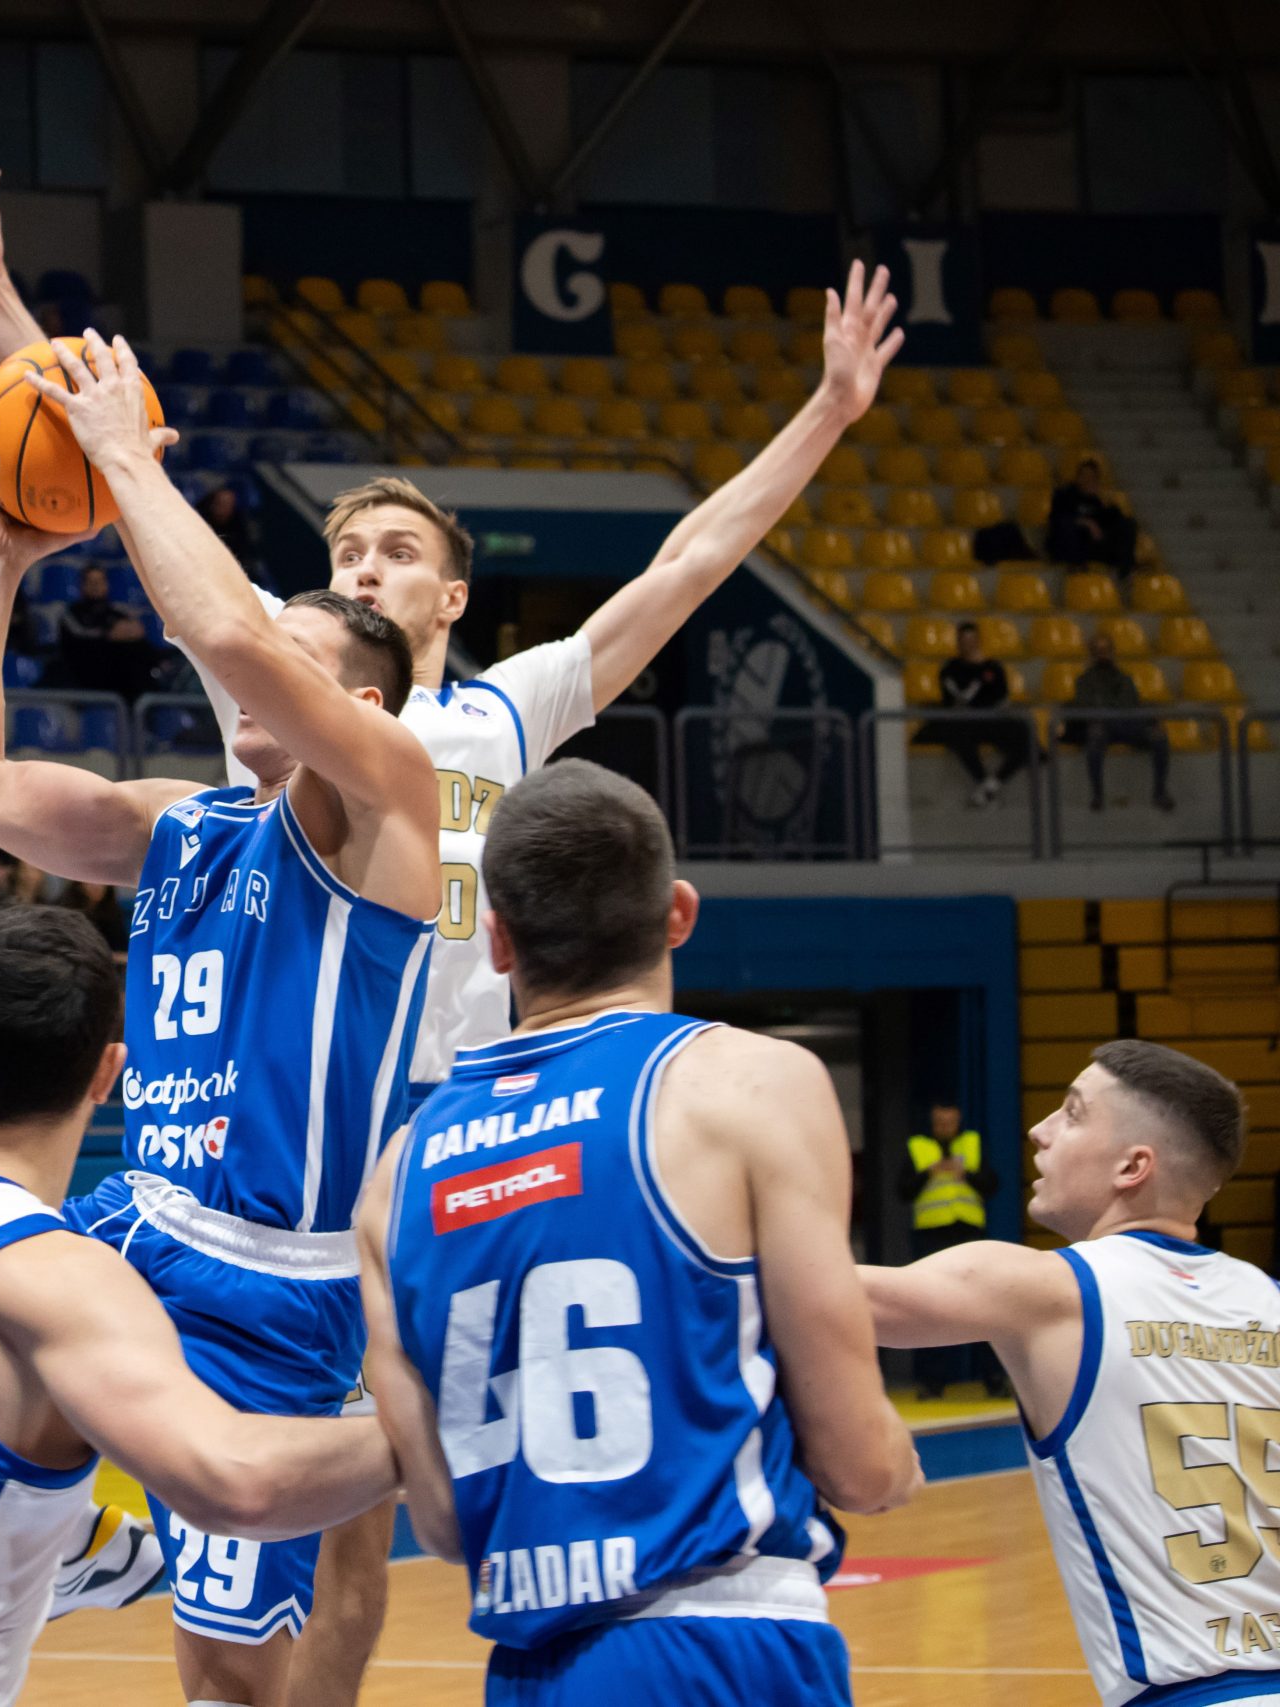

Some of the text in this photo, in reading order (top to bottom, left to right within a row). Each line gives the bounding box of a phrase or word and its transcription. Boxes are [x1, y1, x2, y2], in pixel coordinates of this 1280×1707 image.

[152, 949, 224, 1041] 29
[138, 1124, 207, 1170] PSK
[421, 1087, 605, 1170] RAMLJAK
[445, 1164, 566, 1214] PETROL
[438, 1257, 654, 1484] 46
[169, 1511, 263, 1611] 29
[489, 1536, 641, 1615] ZADAR
